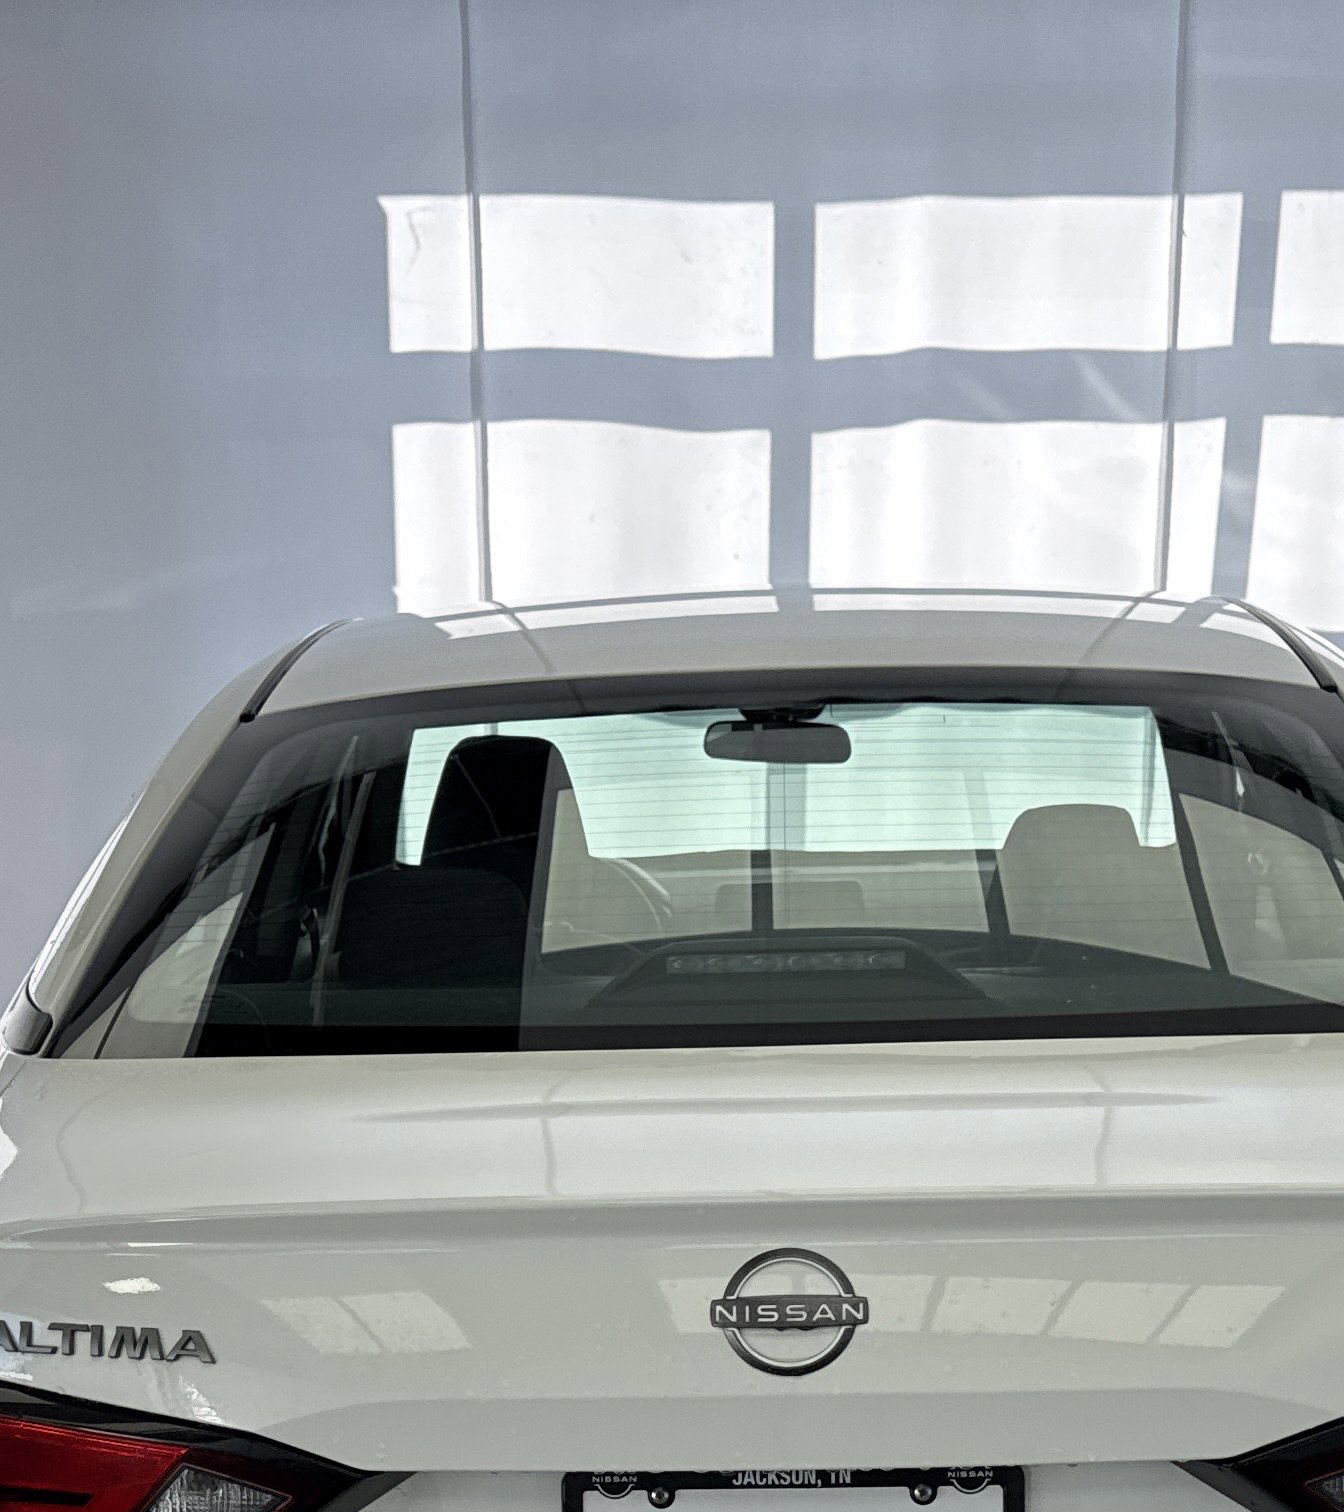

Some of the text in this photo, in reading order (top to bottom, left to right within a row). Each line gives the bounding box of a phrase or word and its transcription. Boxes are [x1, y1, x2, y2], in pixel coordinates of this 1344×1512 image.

[714, 1302, 865, 1324] NISSAN
[591, 1475, 638, 1483] NISSAN
[732, 1468, 852, 1488] JACKSON, TN
[947, 1470, 994, 1478] NISSAN
